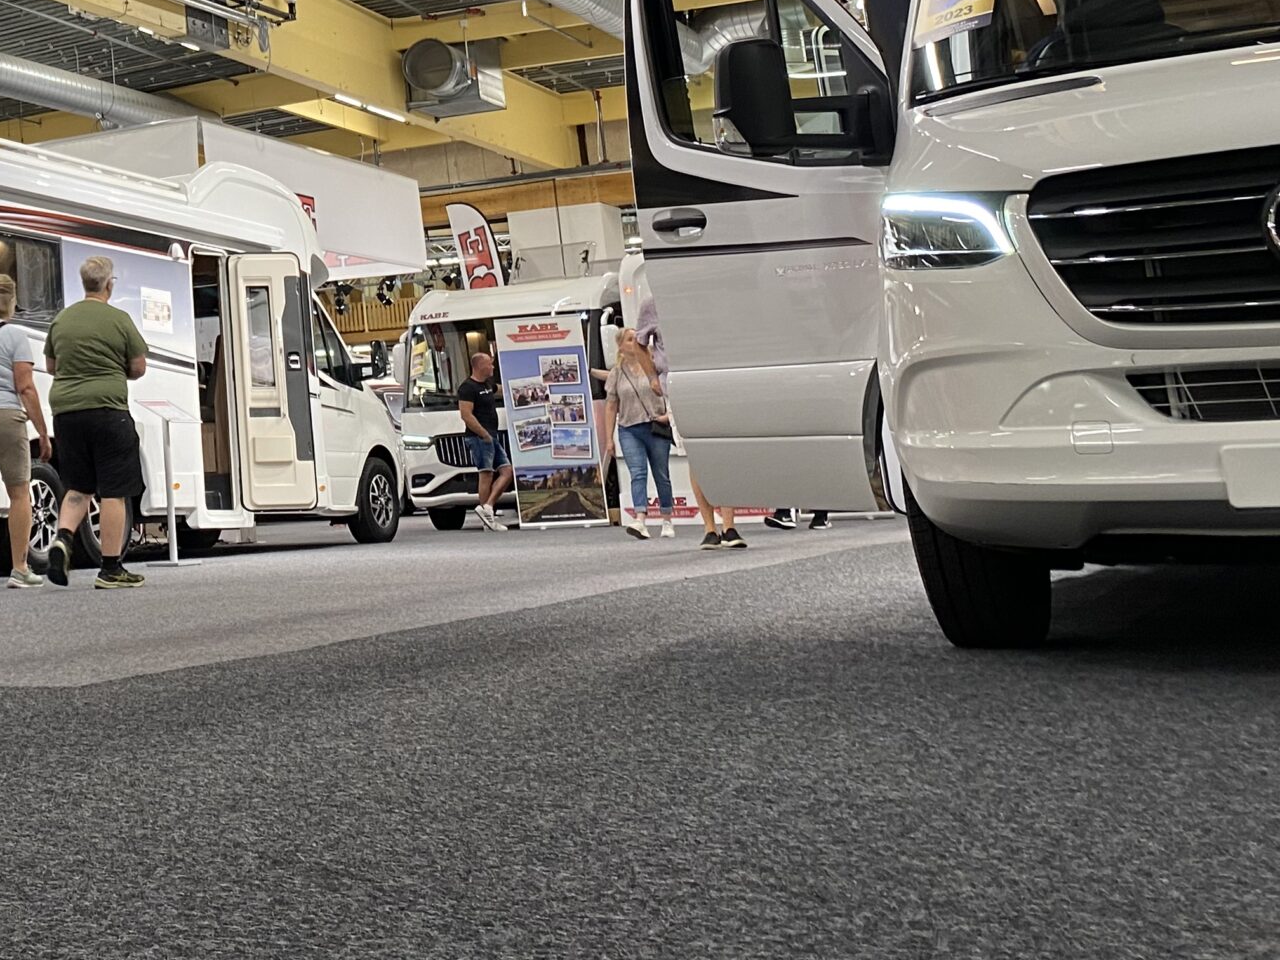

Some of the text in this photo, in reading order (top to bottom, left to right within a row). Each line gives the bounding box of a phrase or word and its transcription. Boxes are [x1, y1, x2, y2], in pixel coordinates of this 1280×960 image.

[934, 5, 973, 25] 2023
[458, 225, 498, 289] BE
[420, 312, 449, 321] KABE
[517, 323, 558, 333] KABE
